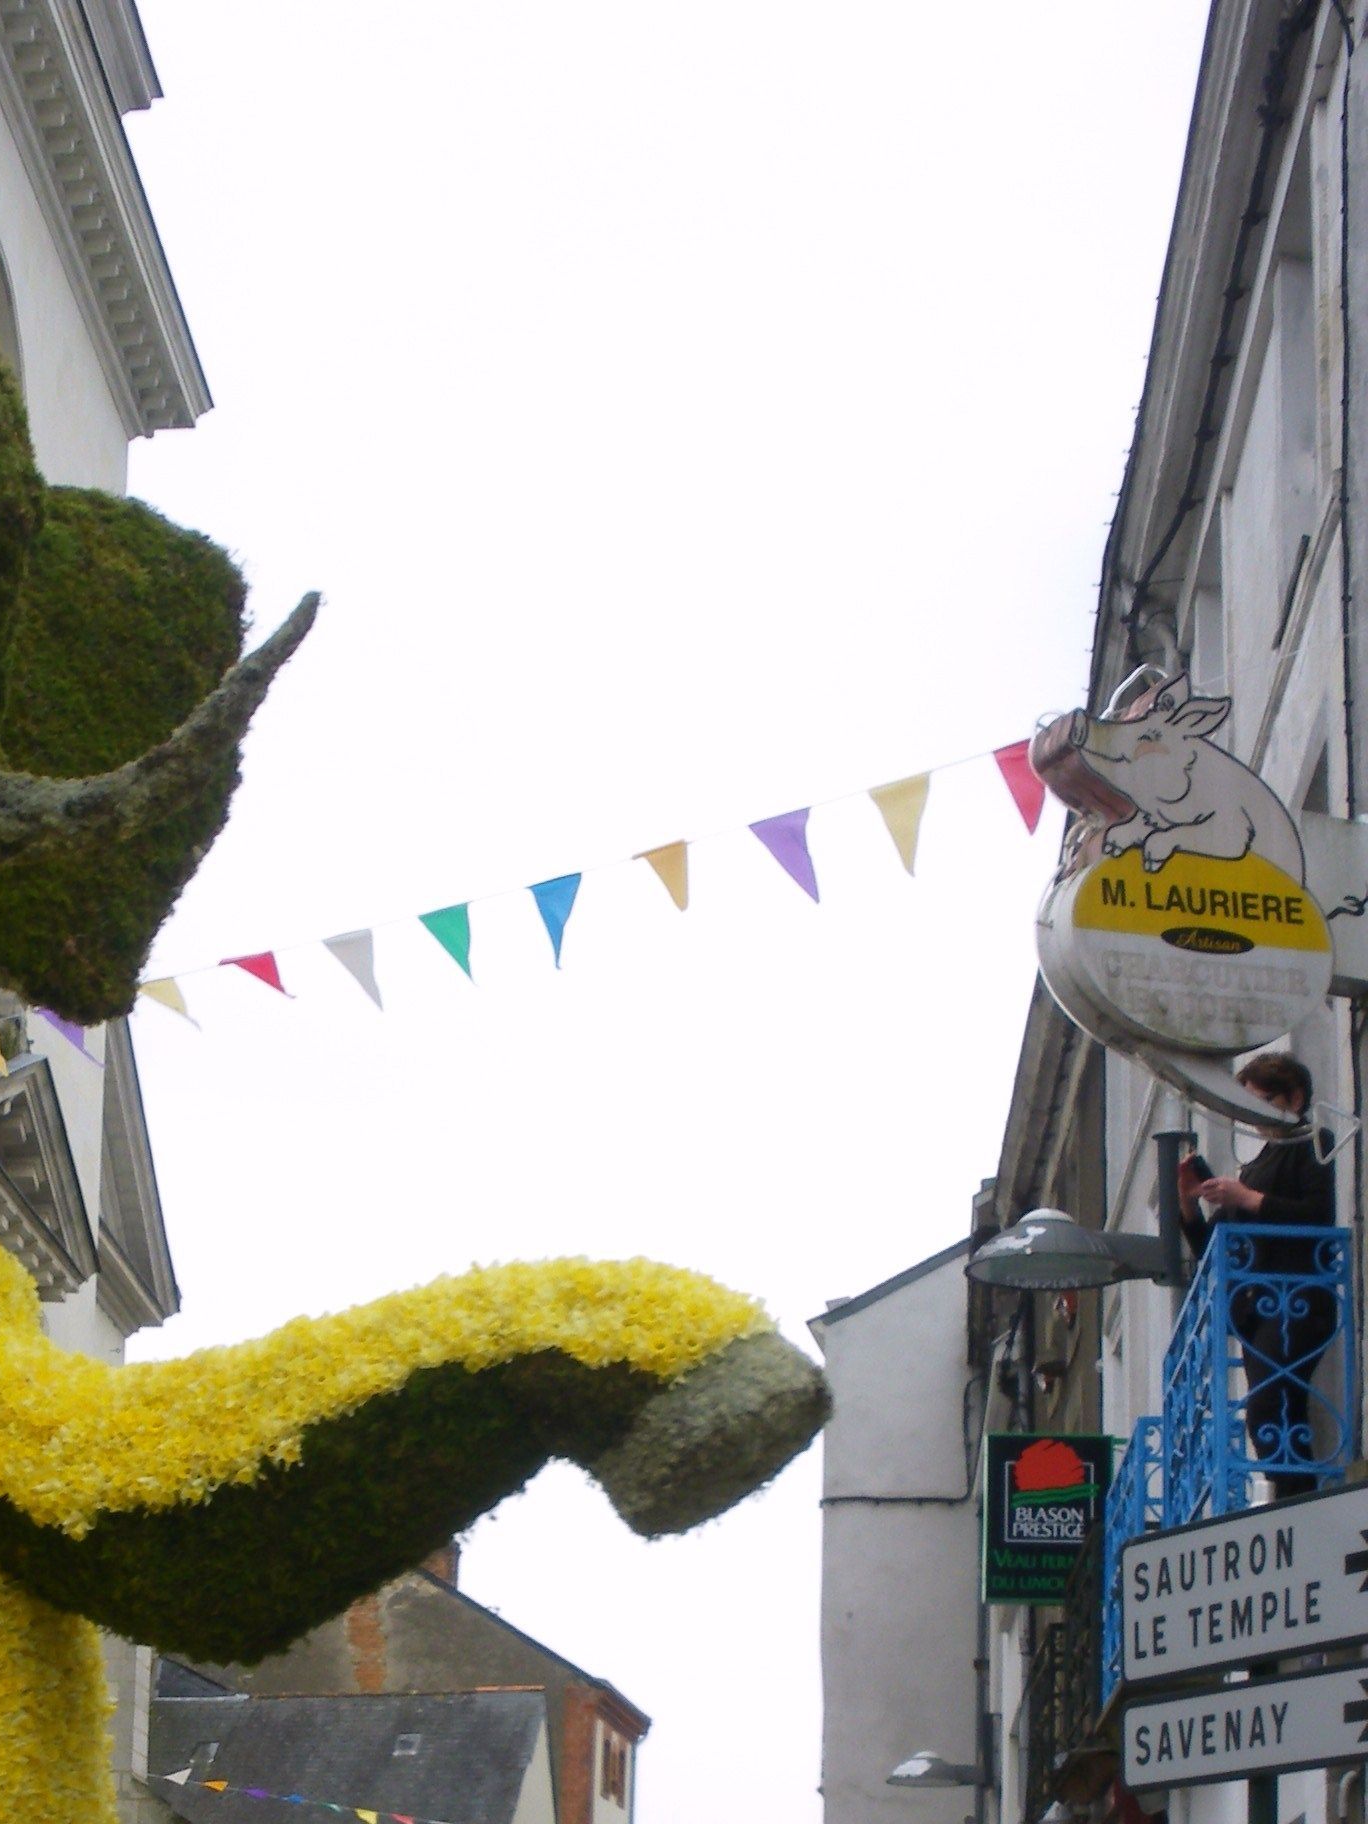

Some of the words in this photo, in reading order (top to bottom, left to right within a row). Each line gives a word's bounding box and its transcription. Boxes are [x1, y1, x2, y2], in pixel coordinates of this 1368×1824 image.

[1101, 877, 1136, 907] M.
[1145, 881, 1305, 926] LAURIERE
[1012, 1521, 1086, 1538] PRESTIGE
[1015, 1507, 1085, 1523] BLASON
[1134, 1526, 1294, 1602] SAUTRON
[1134, 1615, 1168, 1660] LE
[1188, 1581, 1322, 1648] TEMPLE
[1135, 1701, 1289, 1766] SAVENAY
